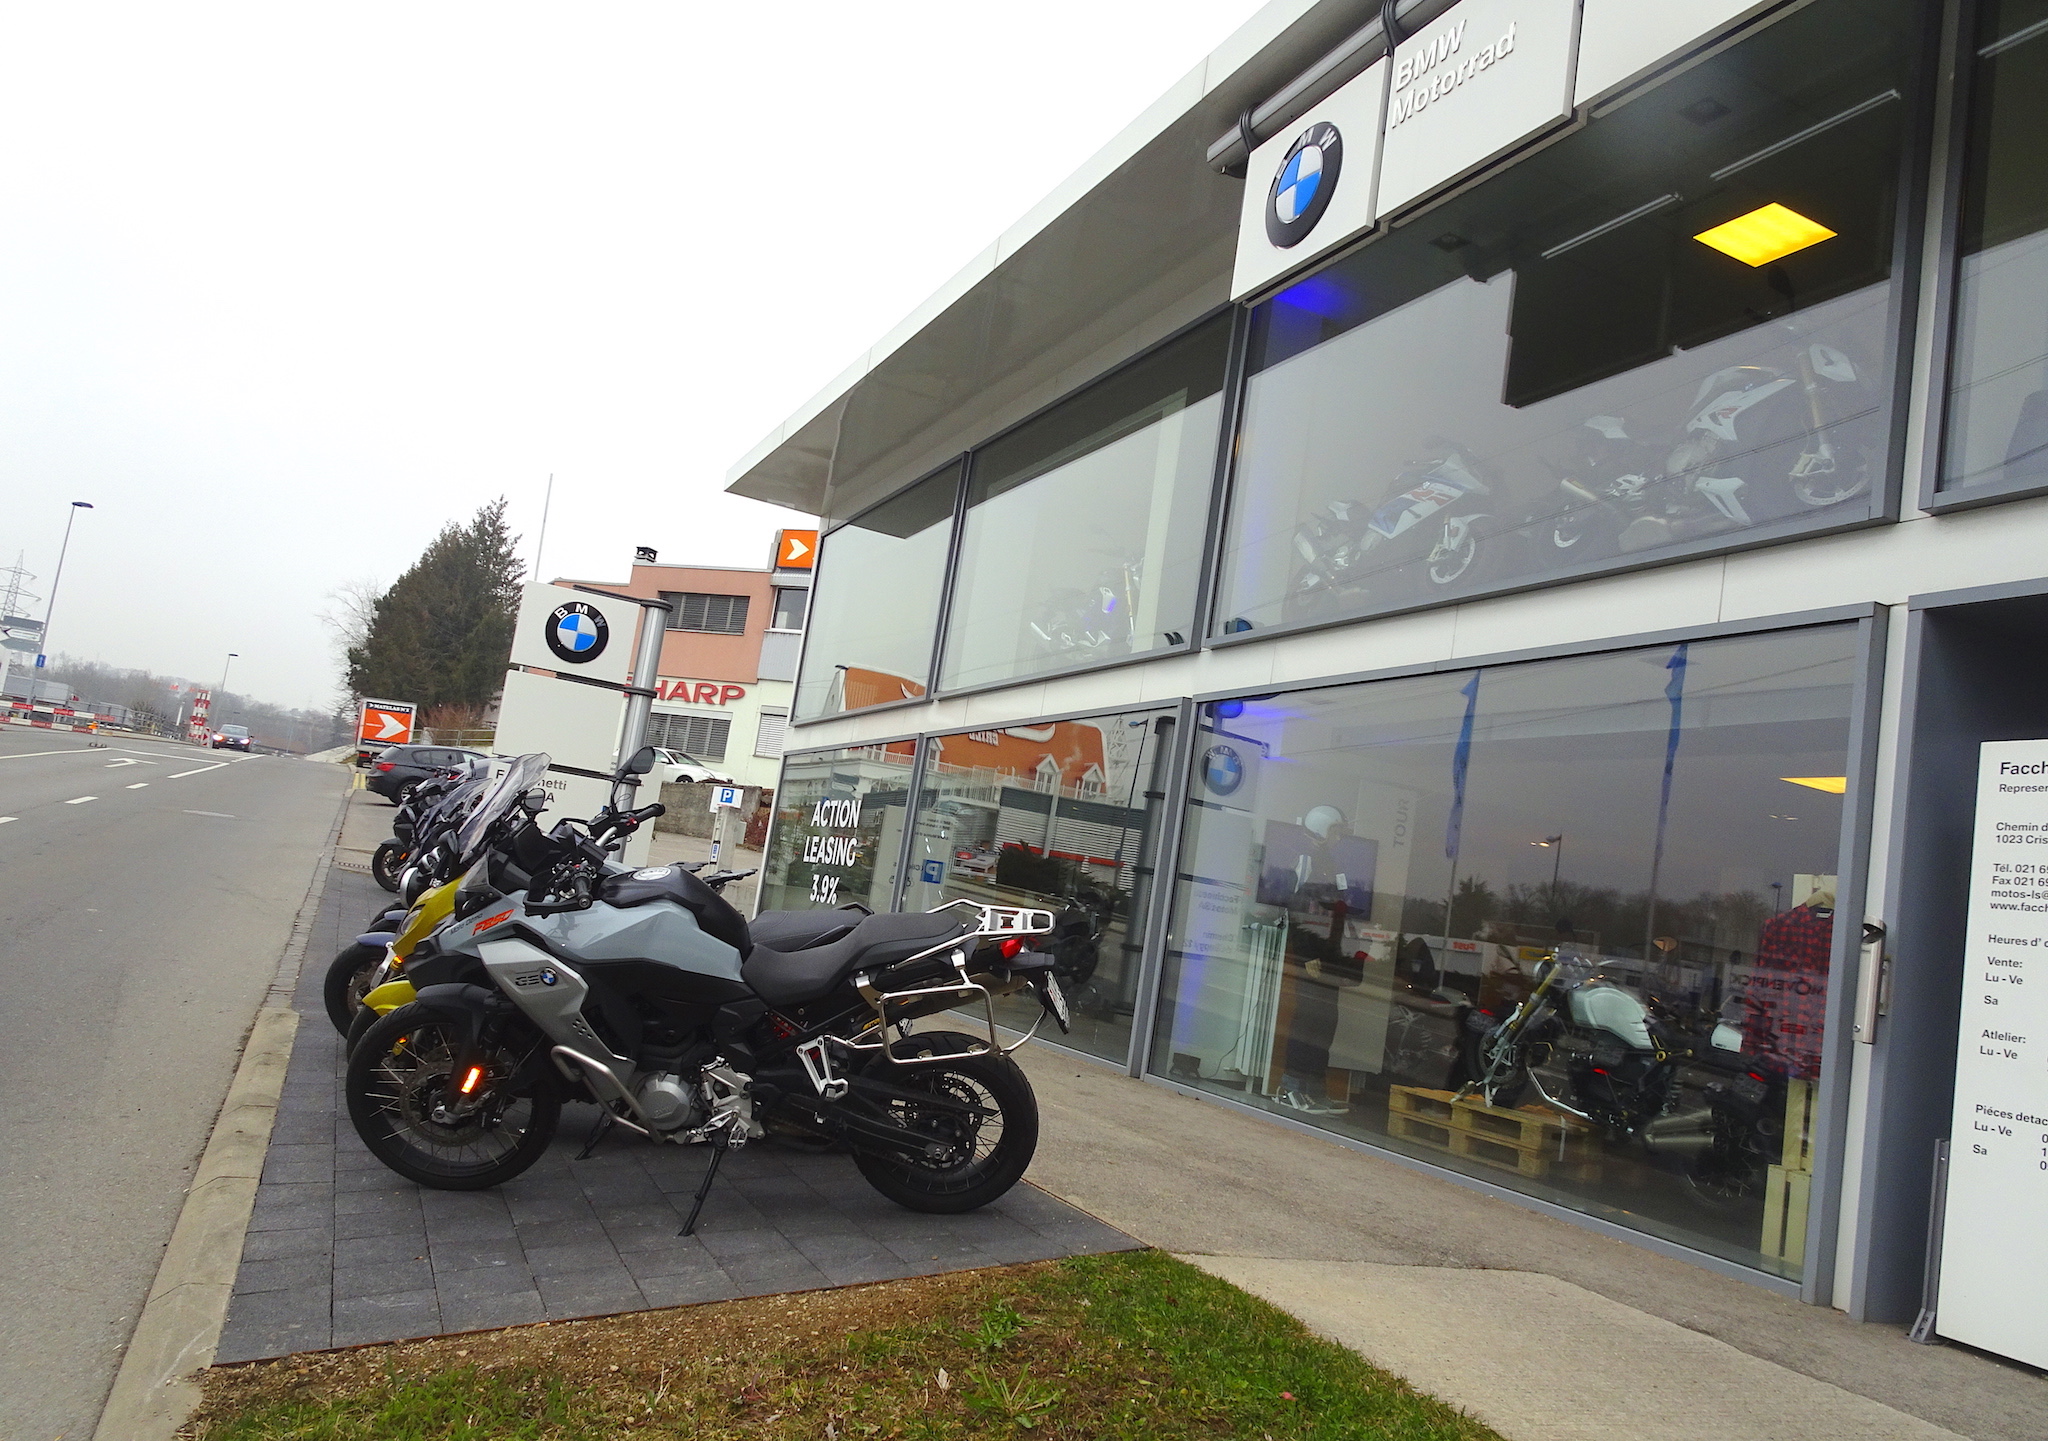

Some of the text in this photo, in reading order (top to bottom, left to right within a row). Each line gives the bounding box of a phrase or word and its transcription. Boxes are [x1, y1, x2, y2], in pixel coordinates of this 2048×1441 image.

[1396, 19, 1467, 93] BMW
[1392, 21, 1516, 129] Motorrad
[1276, 126, 1338, 180] BMW
[554, 603, 607, 628] BMW
[810, 799, 862, 828] ACTION
[1996, 822, 2038, 832] Chemin
[1995, 834, 2023, 844] 1023
[803, 836, 858, 867] LEASING
[1993, 863, 2012, 873] Tél.
[2015, 864, 2035, 874] 021
[1992, 876, 2011, 885] Fax
[2013, 877, 2034, 886] 021
[809, 874, 840, 905] 3.9%
[1988, 934, 2028, 946] Heures
[1987, 956, 2023, 968] Vente:
[1985, 972, 1999, 982] Lu
[2009, 975, 2023, 985] Ve
[1984, 995, 1998, 1005] Sa
[1981, 1029, 2026, 1044] Atlelier:
[1979, 1045, 1994, 1056] Lu
[2003, 1048, 2018, 1060] Ve
[1974, 1120, 1988, 1132] Lu
[1998, 1124, 2012, 1137] Ve
[1972, 1144, 1987, 1155] Sa
